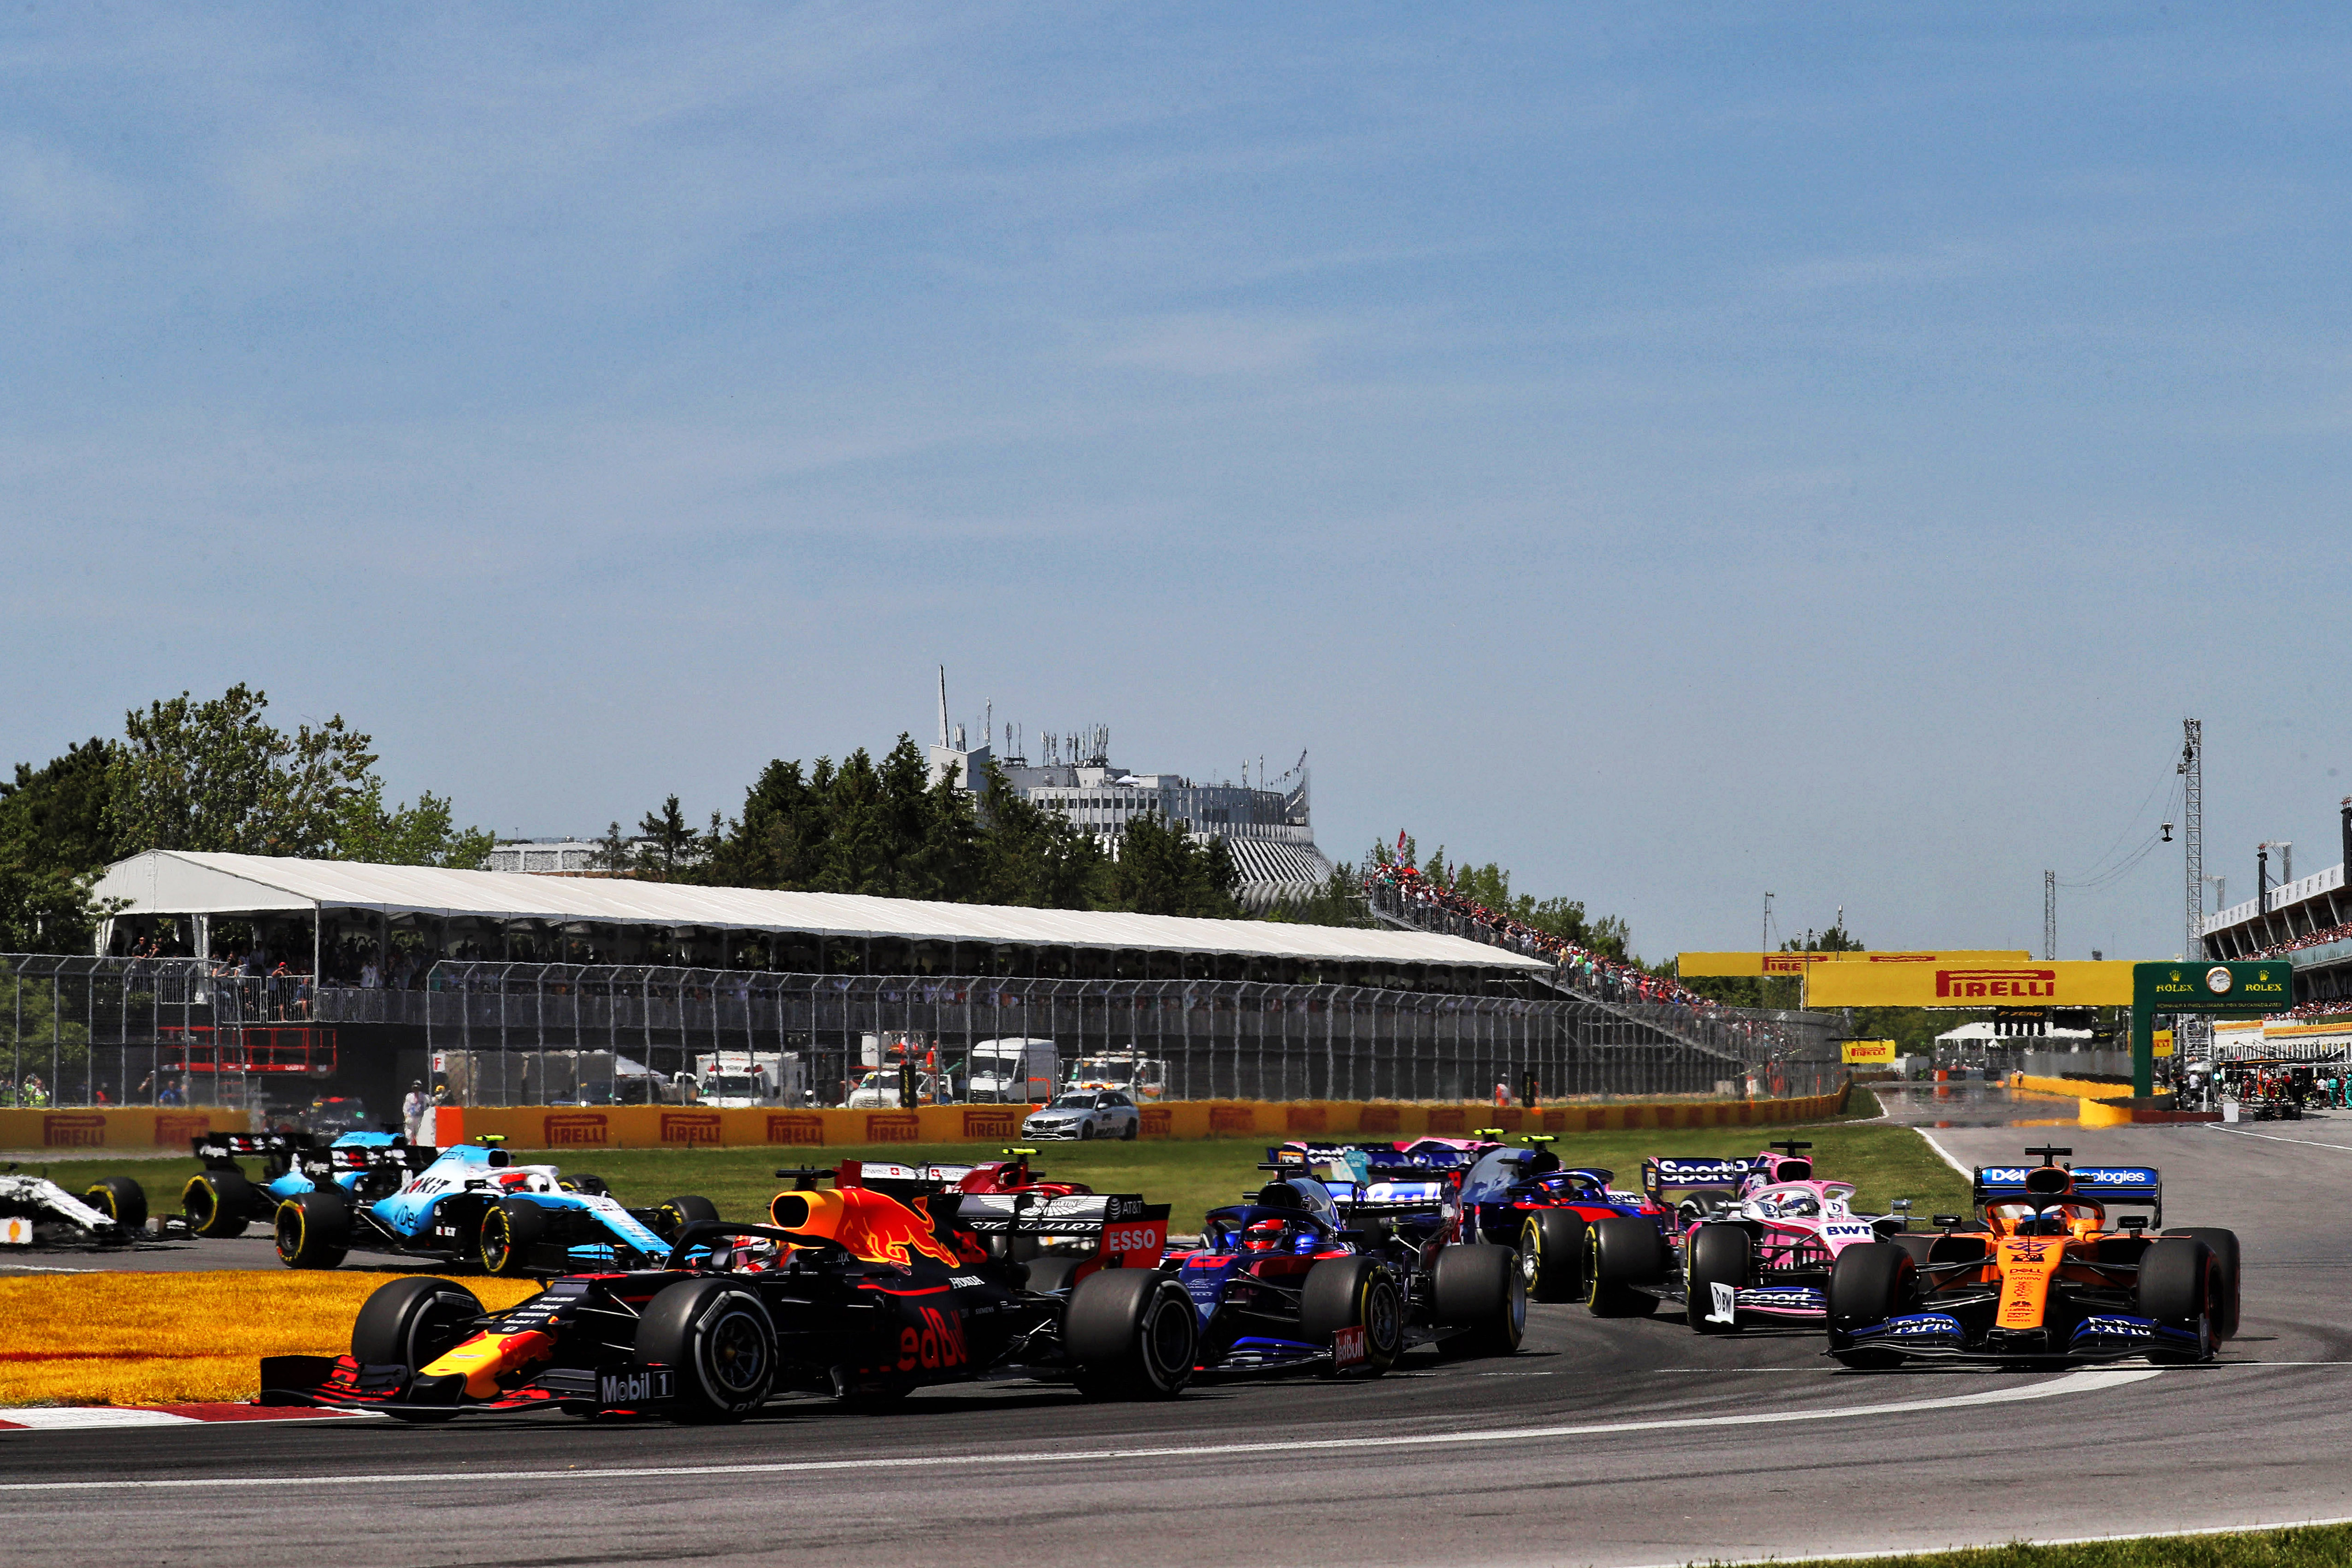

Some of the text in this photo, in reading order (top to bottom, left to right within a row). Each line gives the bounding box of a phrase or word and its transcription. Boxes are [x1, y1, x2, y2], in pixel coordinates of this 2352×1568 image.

[1936, 969, 2056, 997] PIRELLI
[1851, 1047, 1886, 1056] PIRELLI
[43, 1115, 106, 1146] PIRELLI
[543, 1114, 607, 1144] PIRELLI
[661, 1113, 721, 1142] PIRELLI
[767, 1114, 824, 1143] PIRELLI
[867, 1114, 920, 1142] PIRELLI
[963, 1111, 1015, 1138] PIRELLI
[1139, 1108, 1172, 1134] RELLI
[1991, 1169, 2027, 1181] DEL
[1050, 1199, 1078, 1208] MARTIN
[1122, 1201, 1142, 1214] AT&T
[1110, 1229, 1156, 1251] ESSO
[1827, 1226, 1870, 1236] BWT
[949, 1275, 985, 1289] HONDA
[1892, 1317, 1954, 1334] FxPro
[2087, 1316, 2151, 1335] FxPro
[601, 1373, 667, 1403] Mobil 1
